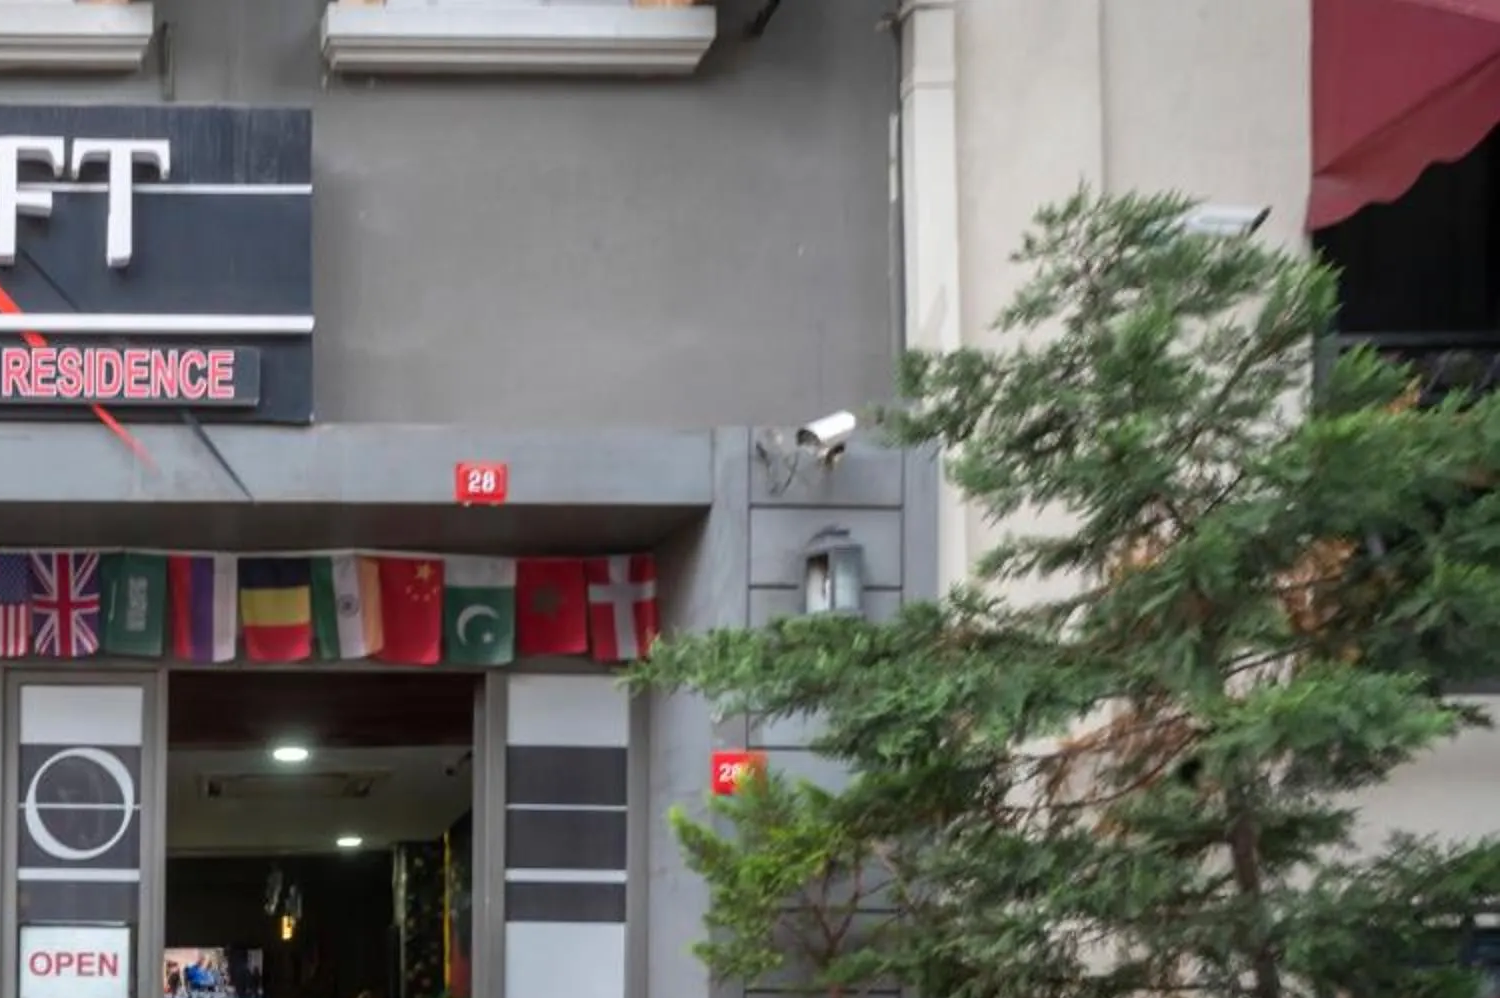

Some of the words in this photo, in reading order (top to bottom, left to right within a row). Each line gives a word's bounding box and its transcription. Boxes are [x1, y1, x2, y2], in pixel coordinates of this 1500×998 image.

[1, 347, 235, 398] RESIDENCE
[467, 468, 496, 493] 28
[28, 951, 119, 978] OPEN
